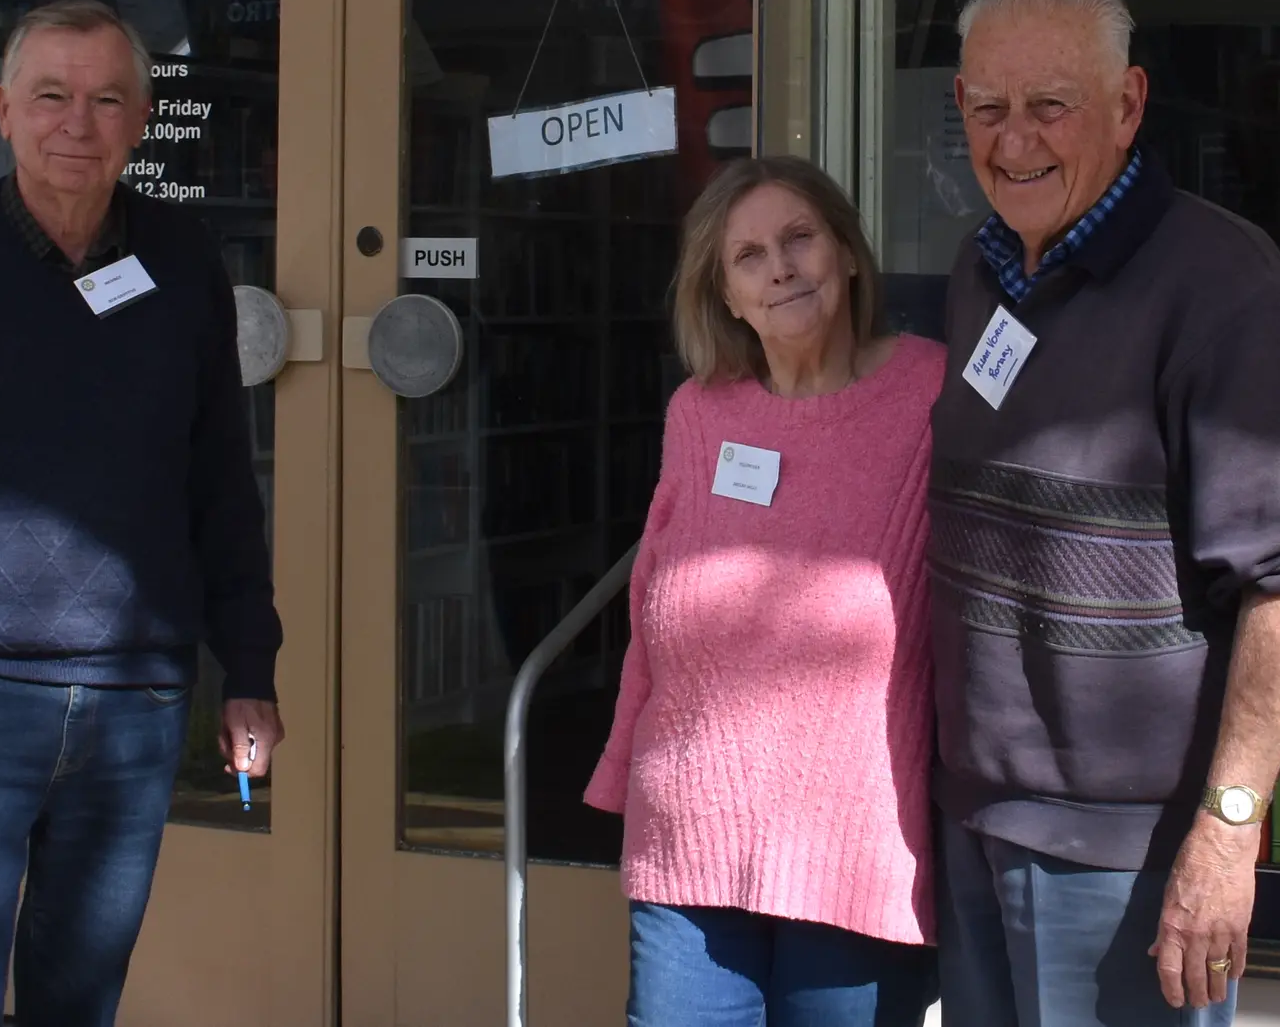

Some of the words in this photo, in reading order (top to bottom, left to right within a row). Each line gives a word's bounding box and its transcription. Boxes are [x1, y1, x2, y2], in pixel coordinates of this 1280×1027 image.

[150, 63, 189, 78] ours
[158, 99, 212, 120] Friday
[541, 103, 624, 147] OPEN
[134, 181, 206, 203] 12.30pm
[414, 249, 465, 267] PUSH
